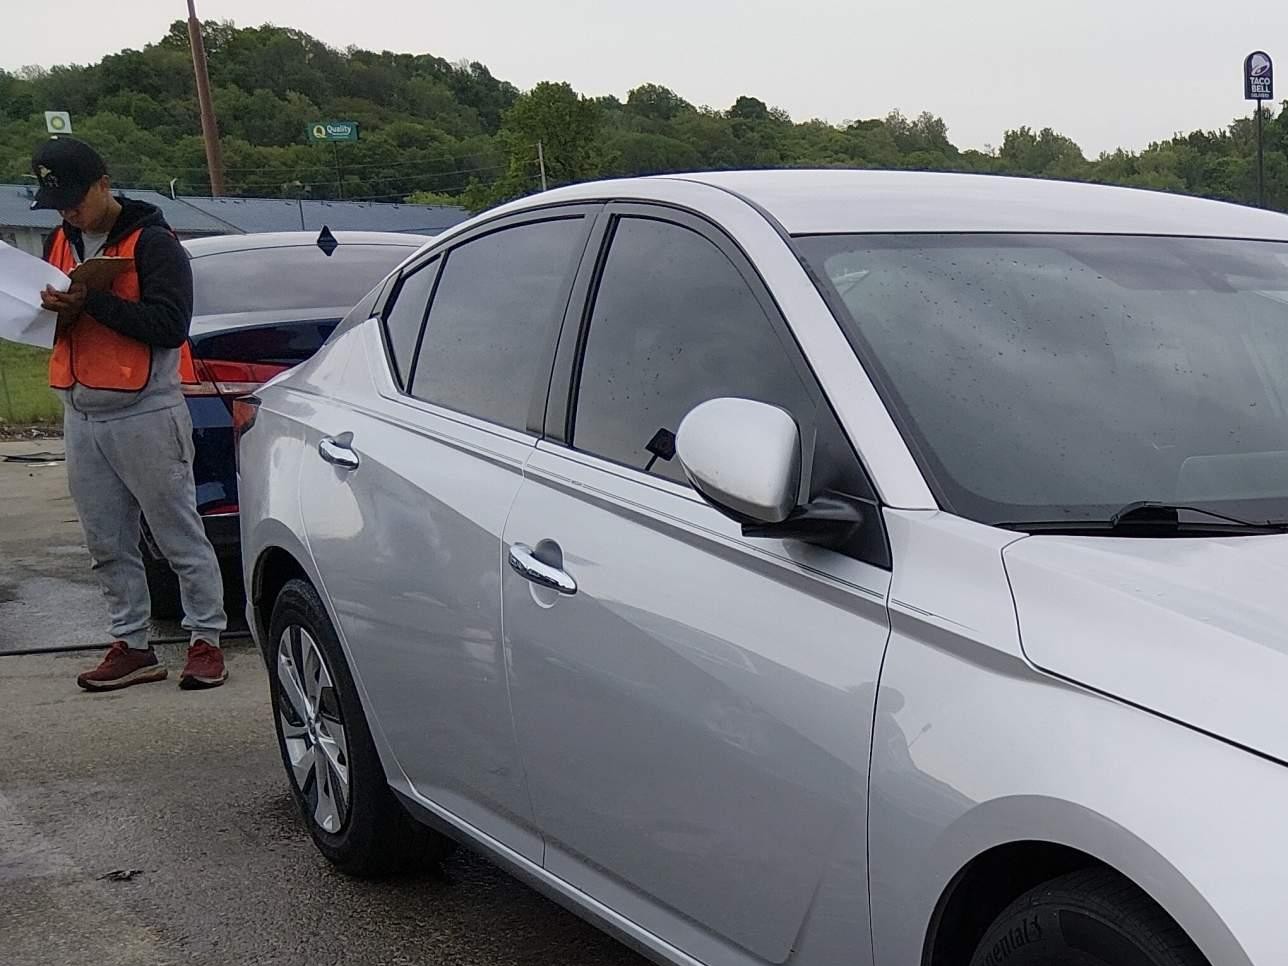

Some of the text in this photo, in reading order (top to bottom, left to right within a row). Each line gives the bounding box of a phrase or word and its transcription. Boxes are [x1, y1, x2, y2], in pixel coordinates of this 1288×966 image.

[1250, 77, 1271, 85] TACO
[1251, 84, 1271, 93] BELL
[326, 124, 351, 136] Quality
